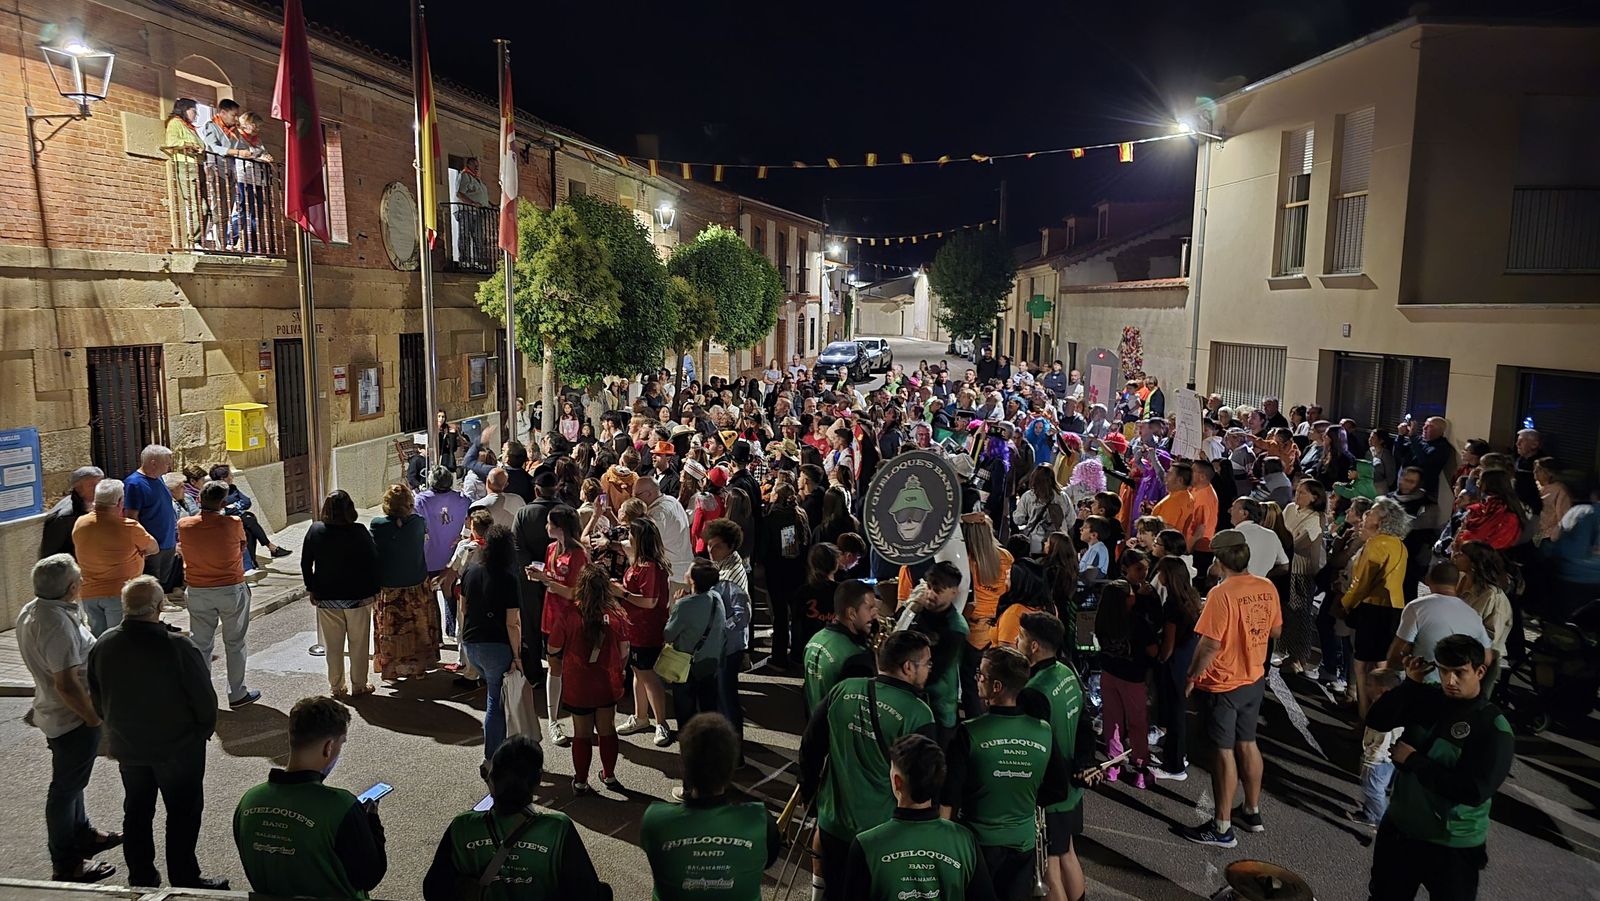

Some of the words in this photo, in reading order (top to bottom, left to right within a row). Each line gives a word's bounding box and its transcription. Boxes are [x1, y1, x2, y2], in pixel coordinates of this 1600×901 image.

[276, 324, 324, 335] POLIVATE
[872, 459, 934, 506] QUELOQUE'S
[933, 465, 954, 501] BAND
[843, 693, 904, 721] QUELQUE'S
[242, 806, 316, 829] QUELOQUE'S
[262, 820, 289, 830] BAND
[466, 838, 549, 854] QUEUE'S
[662, 836, 753, 851] QUELOQUE'S
[881, 849, 962, 870] QUELOQUE'S
